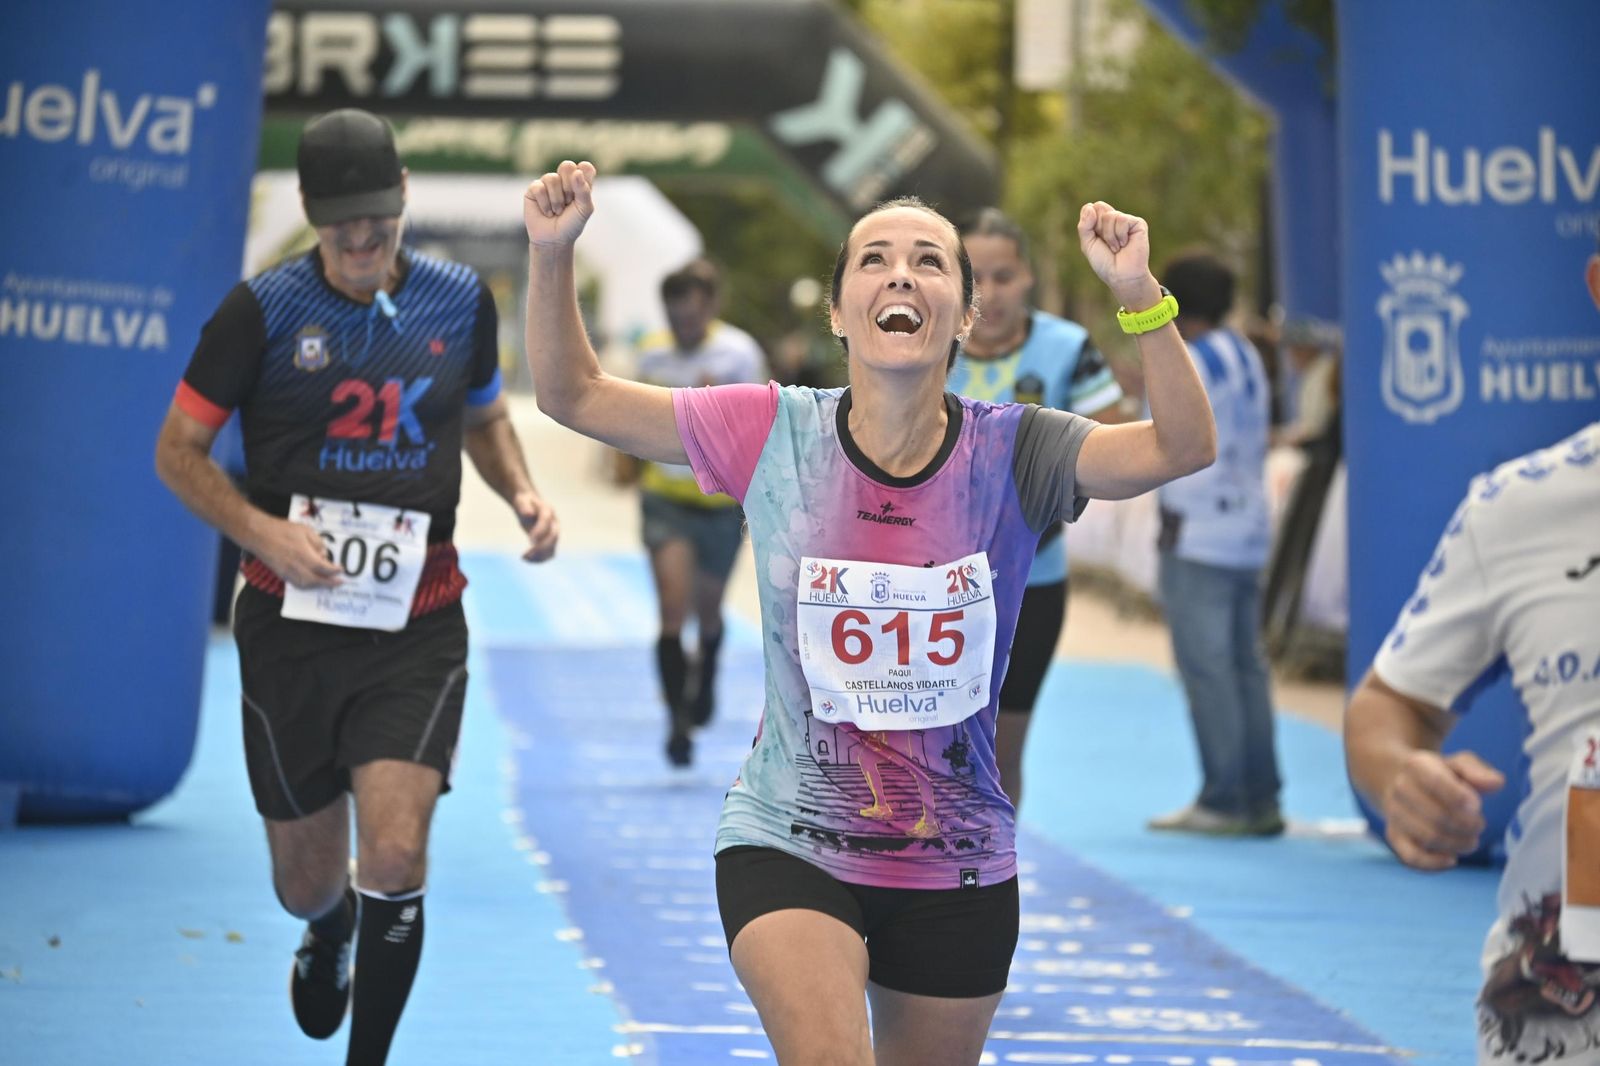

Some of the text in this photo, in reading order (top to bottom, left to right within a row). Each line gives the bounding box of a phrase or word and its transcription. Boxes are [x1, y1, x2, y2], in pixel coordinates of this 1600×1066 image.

[0, 297, 169, 350] HUELVA
[1481, 361, 1600, 403] HUEL
[326, 375, 435, 445] 21K
[318, 444, 430, 472] Huelva
[857, 510, 916, 526] TEAMERGY
[810, 566, 849, 595] 21K
[809, 591, 849, 604] HUELVA
[893, 593, 926, 602] HUELVA
[947, 589, 982, 606] HUELVA
[831, 609, 965, 666] 615
[888, 669, 912, 677] PAQUI
[845, 679, 957, 690] CASTELLANOS VIDARTE
[857, 692, 944, 714] Huelva
[909, 714, 939, 725] original
